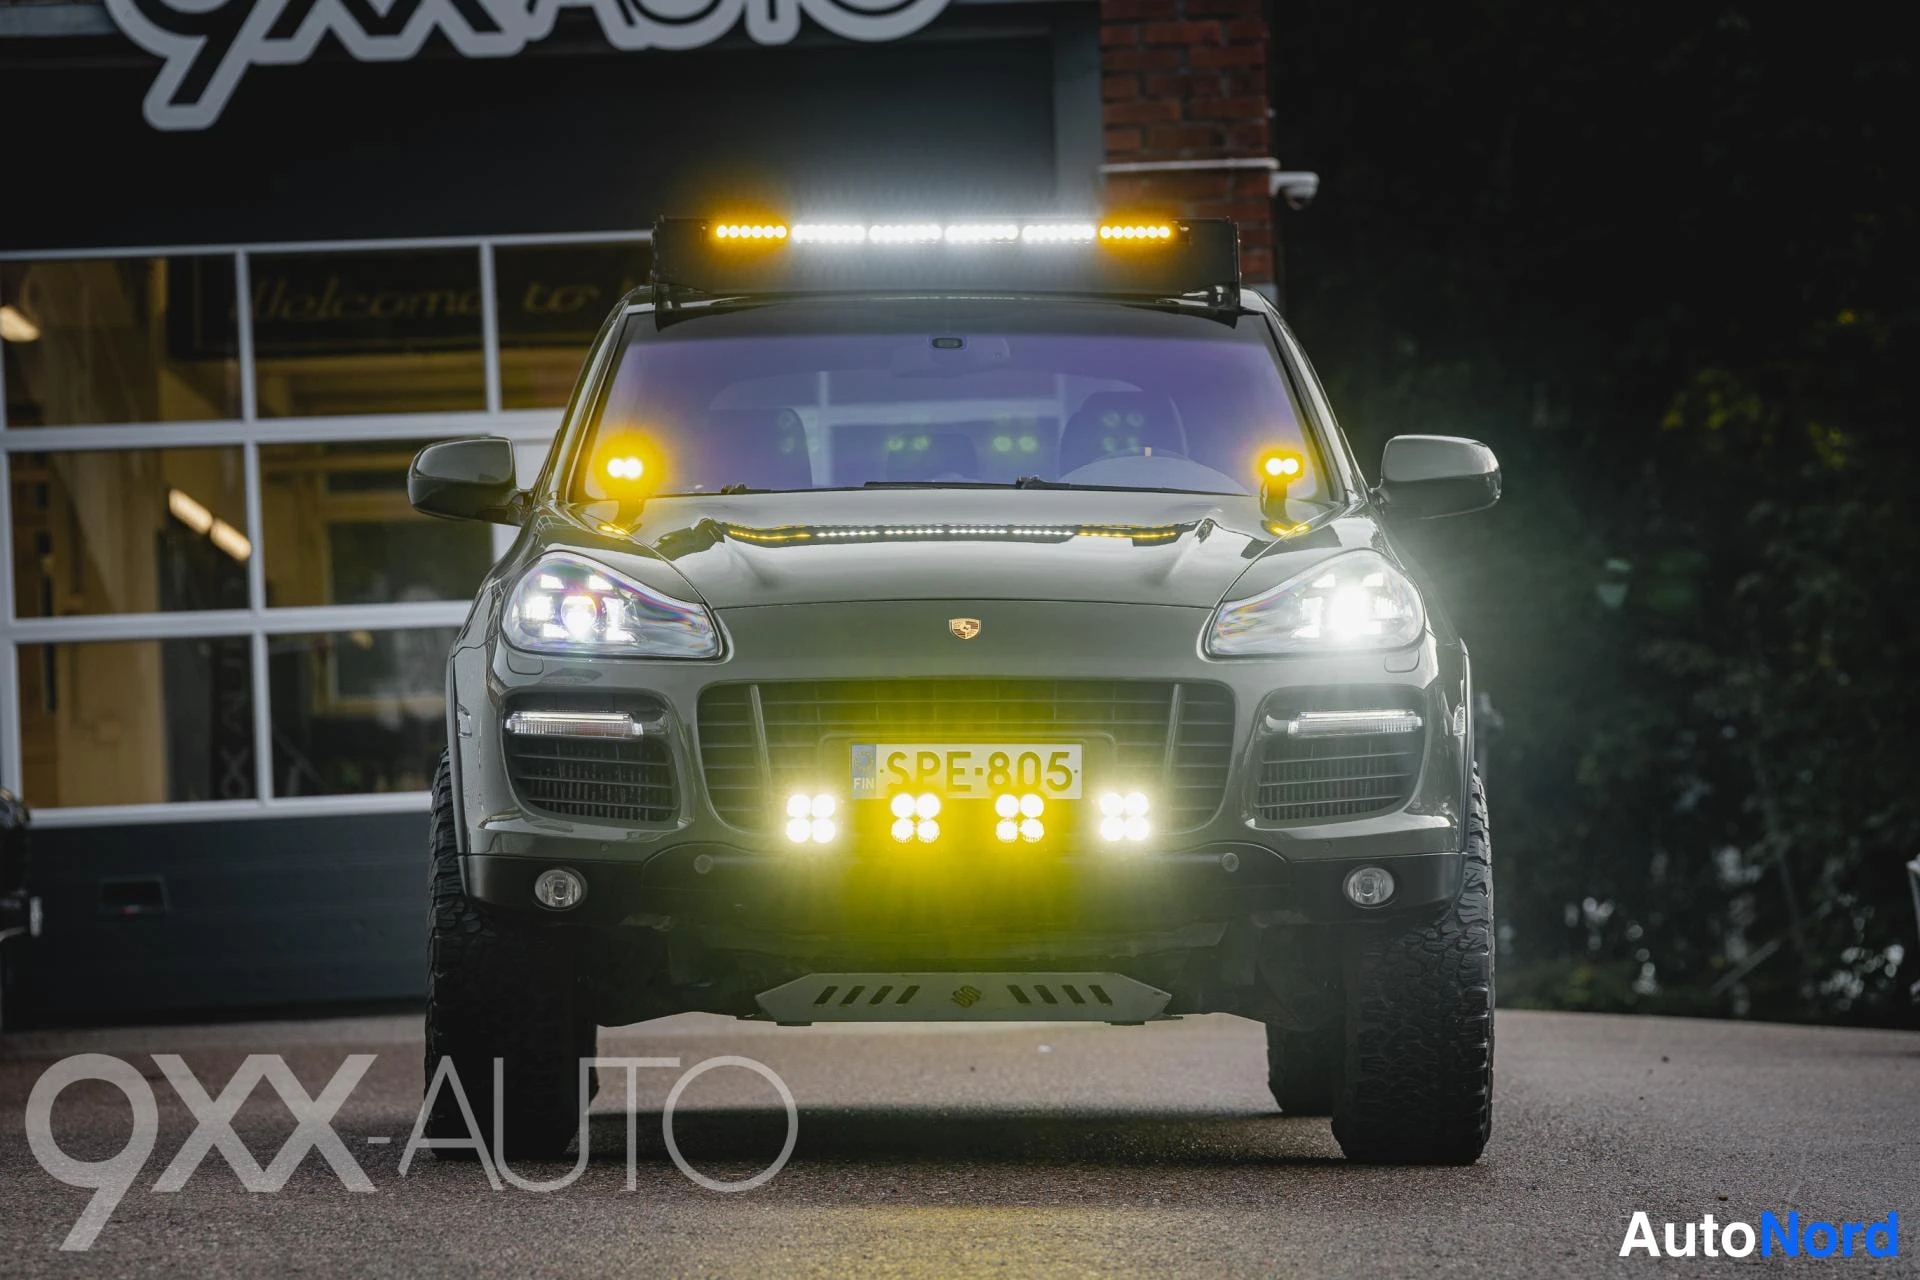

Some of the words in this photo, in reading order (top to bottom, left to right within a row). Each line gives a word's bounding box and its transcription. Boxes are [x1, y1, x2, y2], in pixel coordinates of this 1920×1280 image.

[523, 280, 600, 313] to
[853, 777, 875, 790] FIN
[886, 751, 1073, 792] SPE-805
